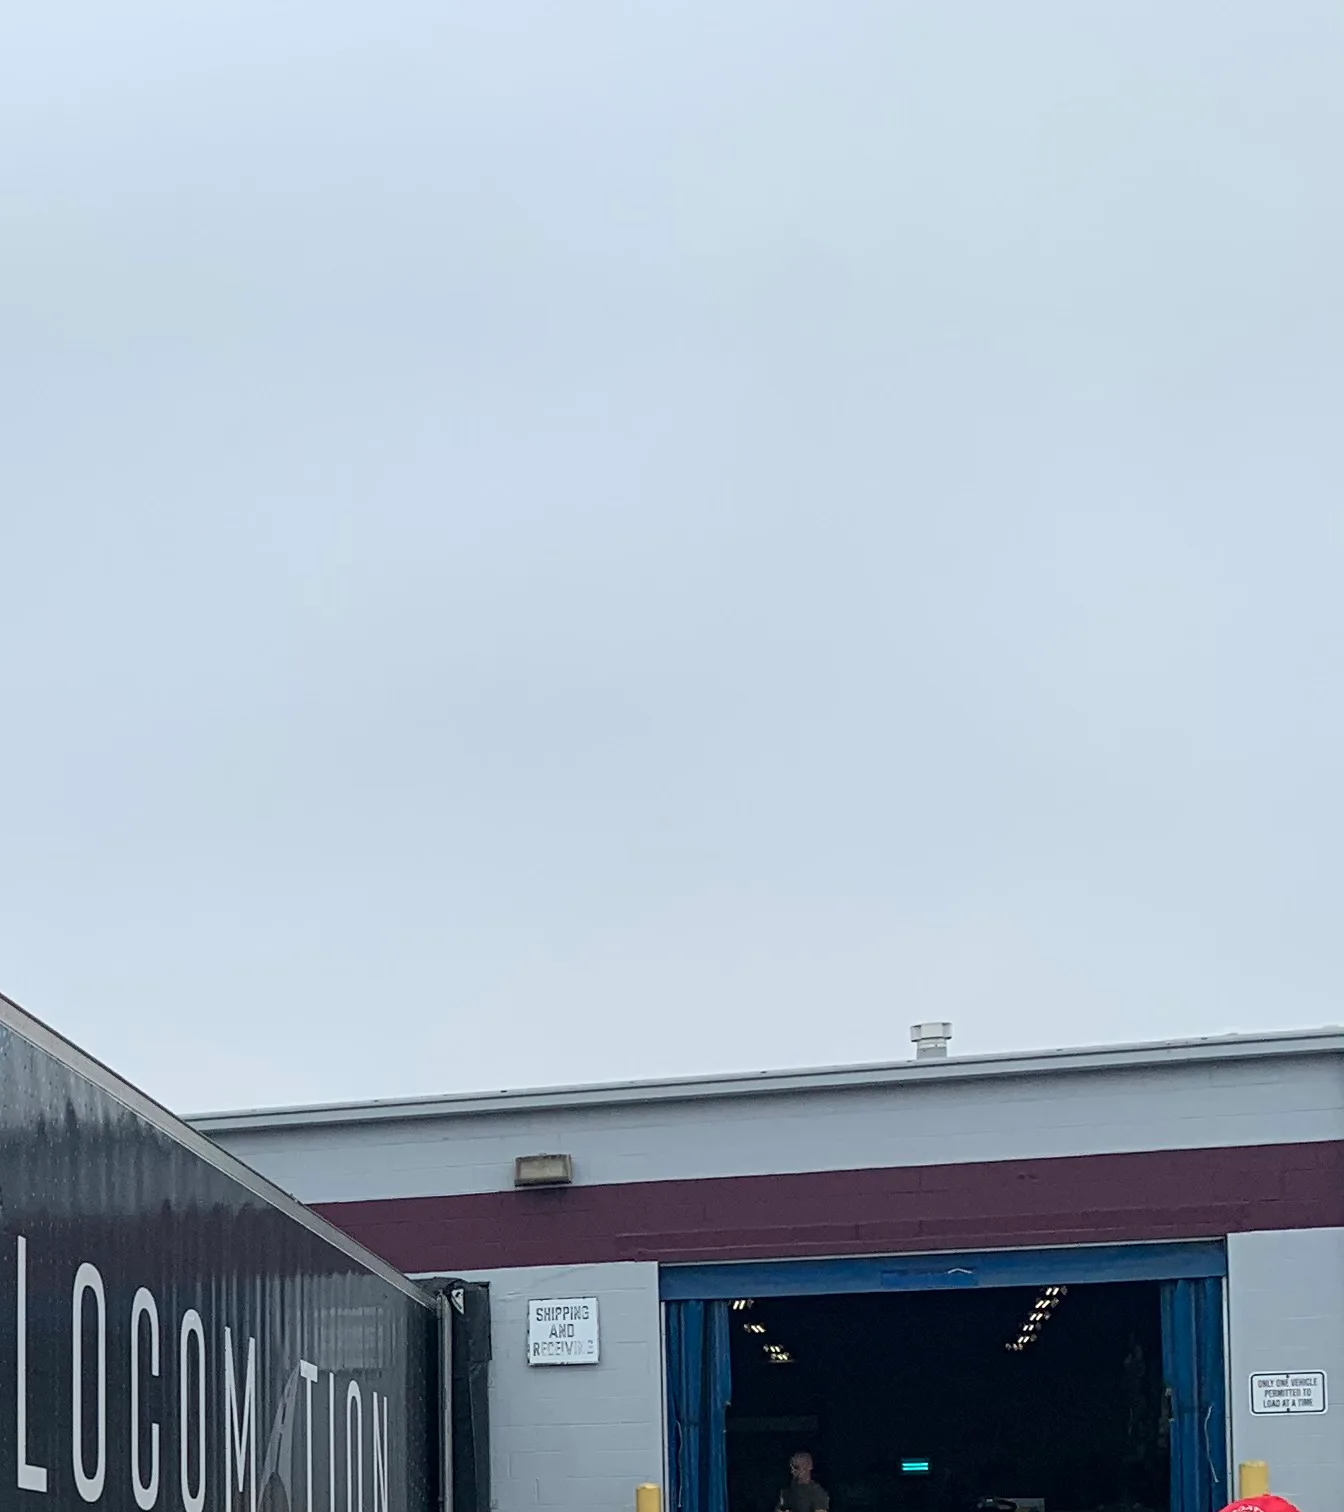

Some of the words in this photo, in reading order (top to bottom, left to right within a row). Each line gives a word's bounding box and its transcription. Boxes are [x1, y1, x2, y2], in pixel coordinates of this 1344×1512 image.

[536, 1305, 590, 1322] SHIPPING
[548, 1323, 575, 1339] AND
[1257, 1379, 1274, 1388] ONLY
[1275, 1378, 1289, 1388] ONE
[1291, 1377, 1318, 1387] VEHICLE
[1264, 1388, 1301, 1398] PERMITTED
[1302, 1388, 1312, 1397] TO
[1263, 1399, 1280, 1408] LOAD
[1281, 1399, 1290, 1407] AT
[1291, 1398, 1297, 1407] A
[1298, 1398, 1313, 1407] TIME
